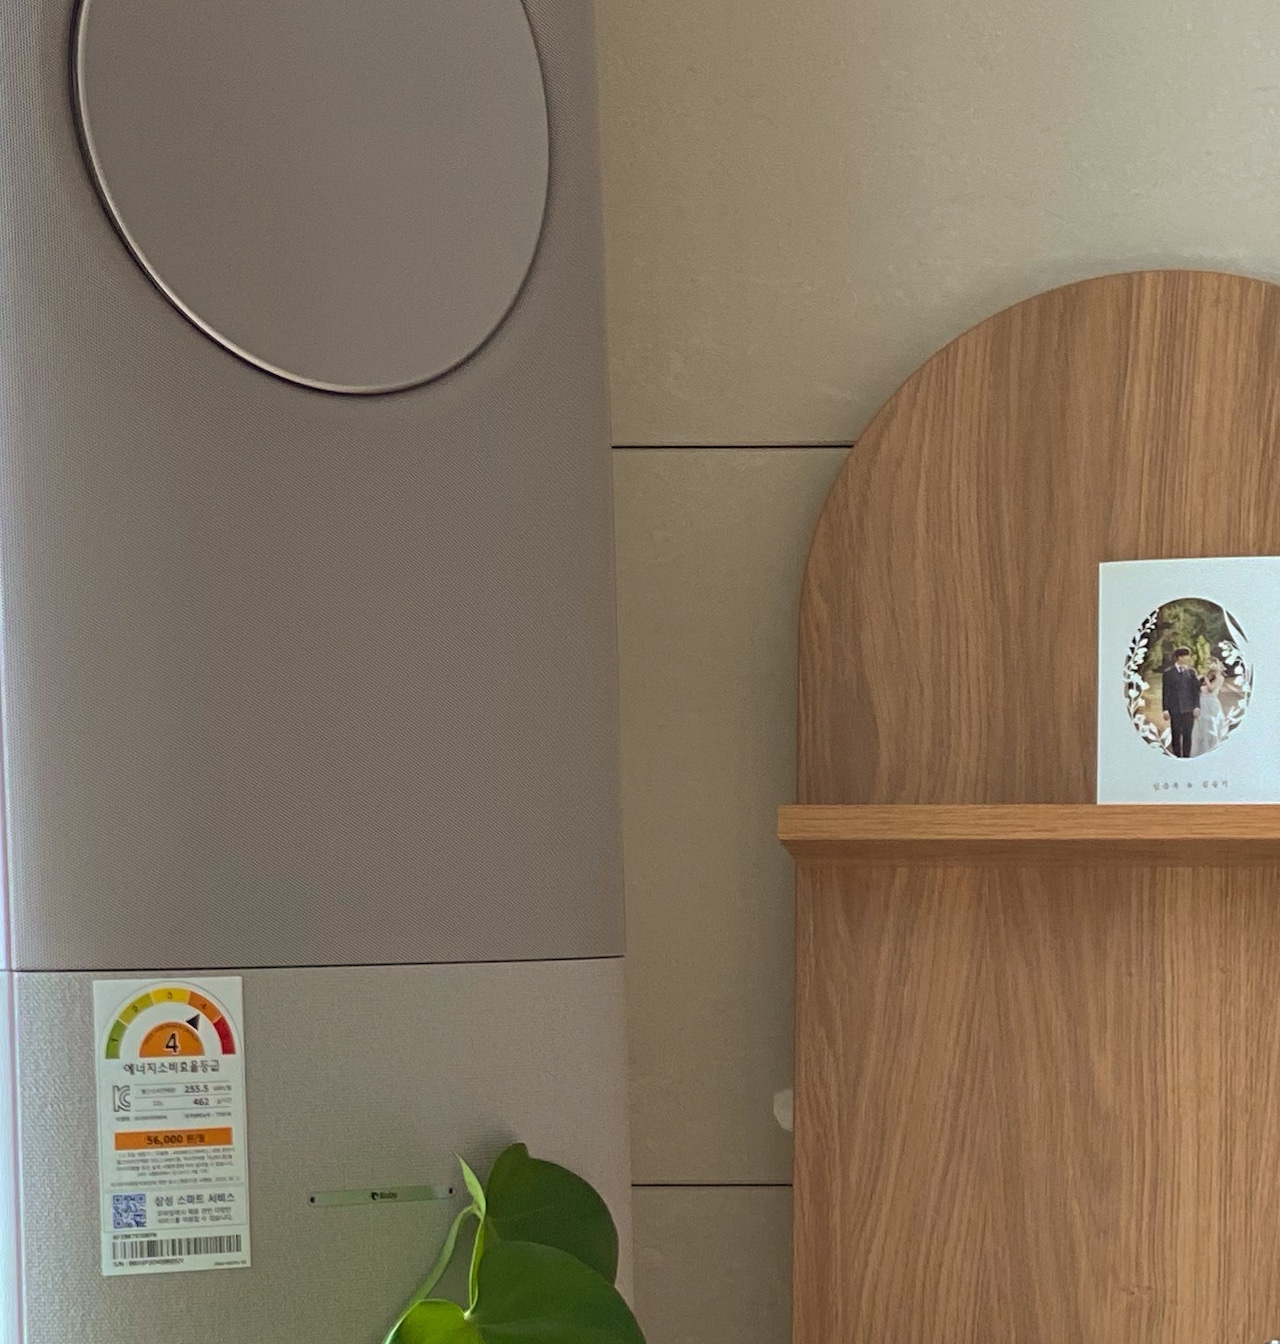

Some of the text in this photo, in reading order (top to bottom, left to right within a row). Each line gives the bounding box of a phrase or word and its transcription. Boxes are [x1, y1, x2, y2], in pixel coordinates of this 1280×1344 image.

[165, 1033, 179, 1053] 4
[123, 1060, 220, 1075] 에너지소비효율등급
[194, 1098, 209, 1106] 462
[155, 1192, 236, 1207] 삼성 스마트 서비스
